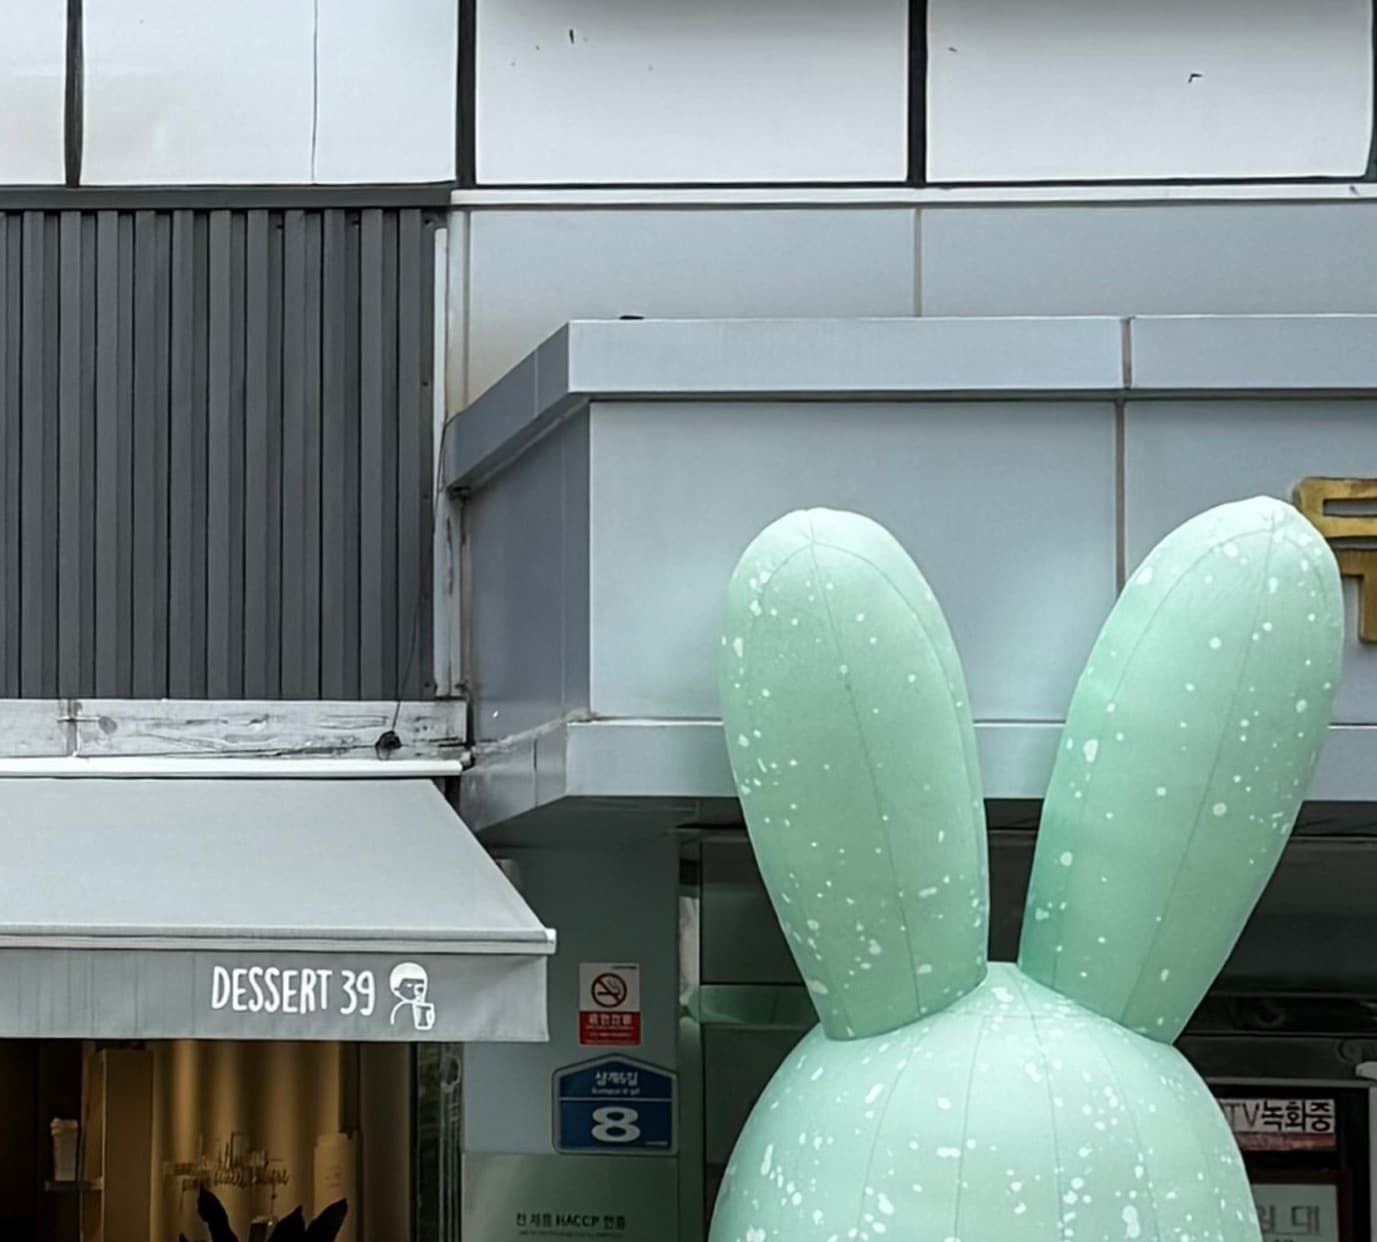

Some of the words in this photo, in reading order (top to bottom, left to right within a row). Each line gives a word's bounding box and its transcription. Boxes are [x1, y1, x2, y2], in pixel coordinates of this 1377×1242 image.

[211, 965, 333, 1014] DESSERT
[340, 969, 375, 1016] 39
[591, 1106, 641, 1143] 8
